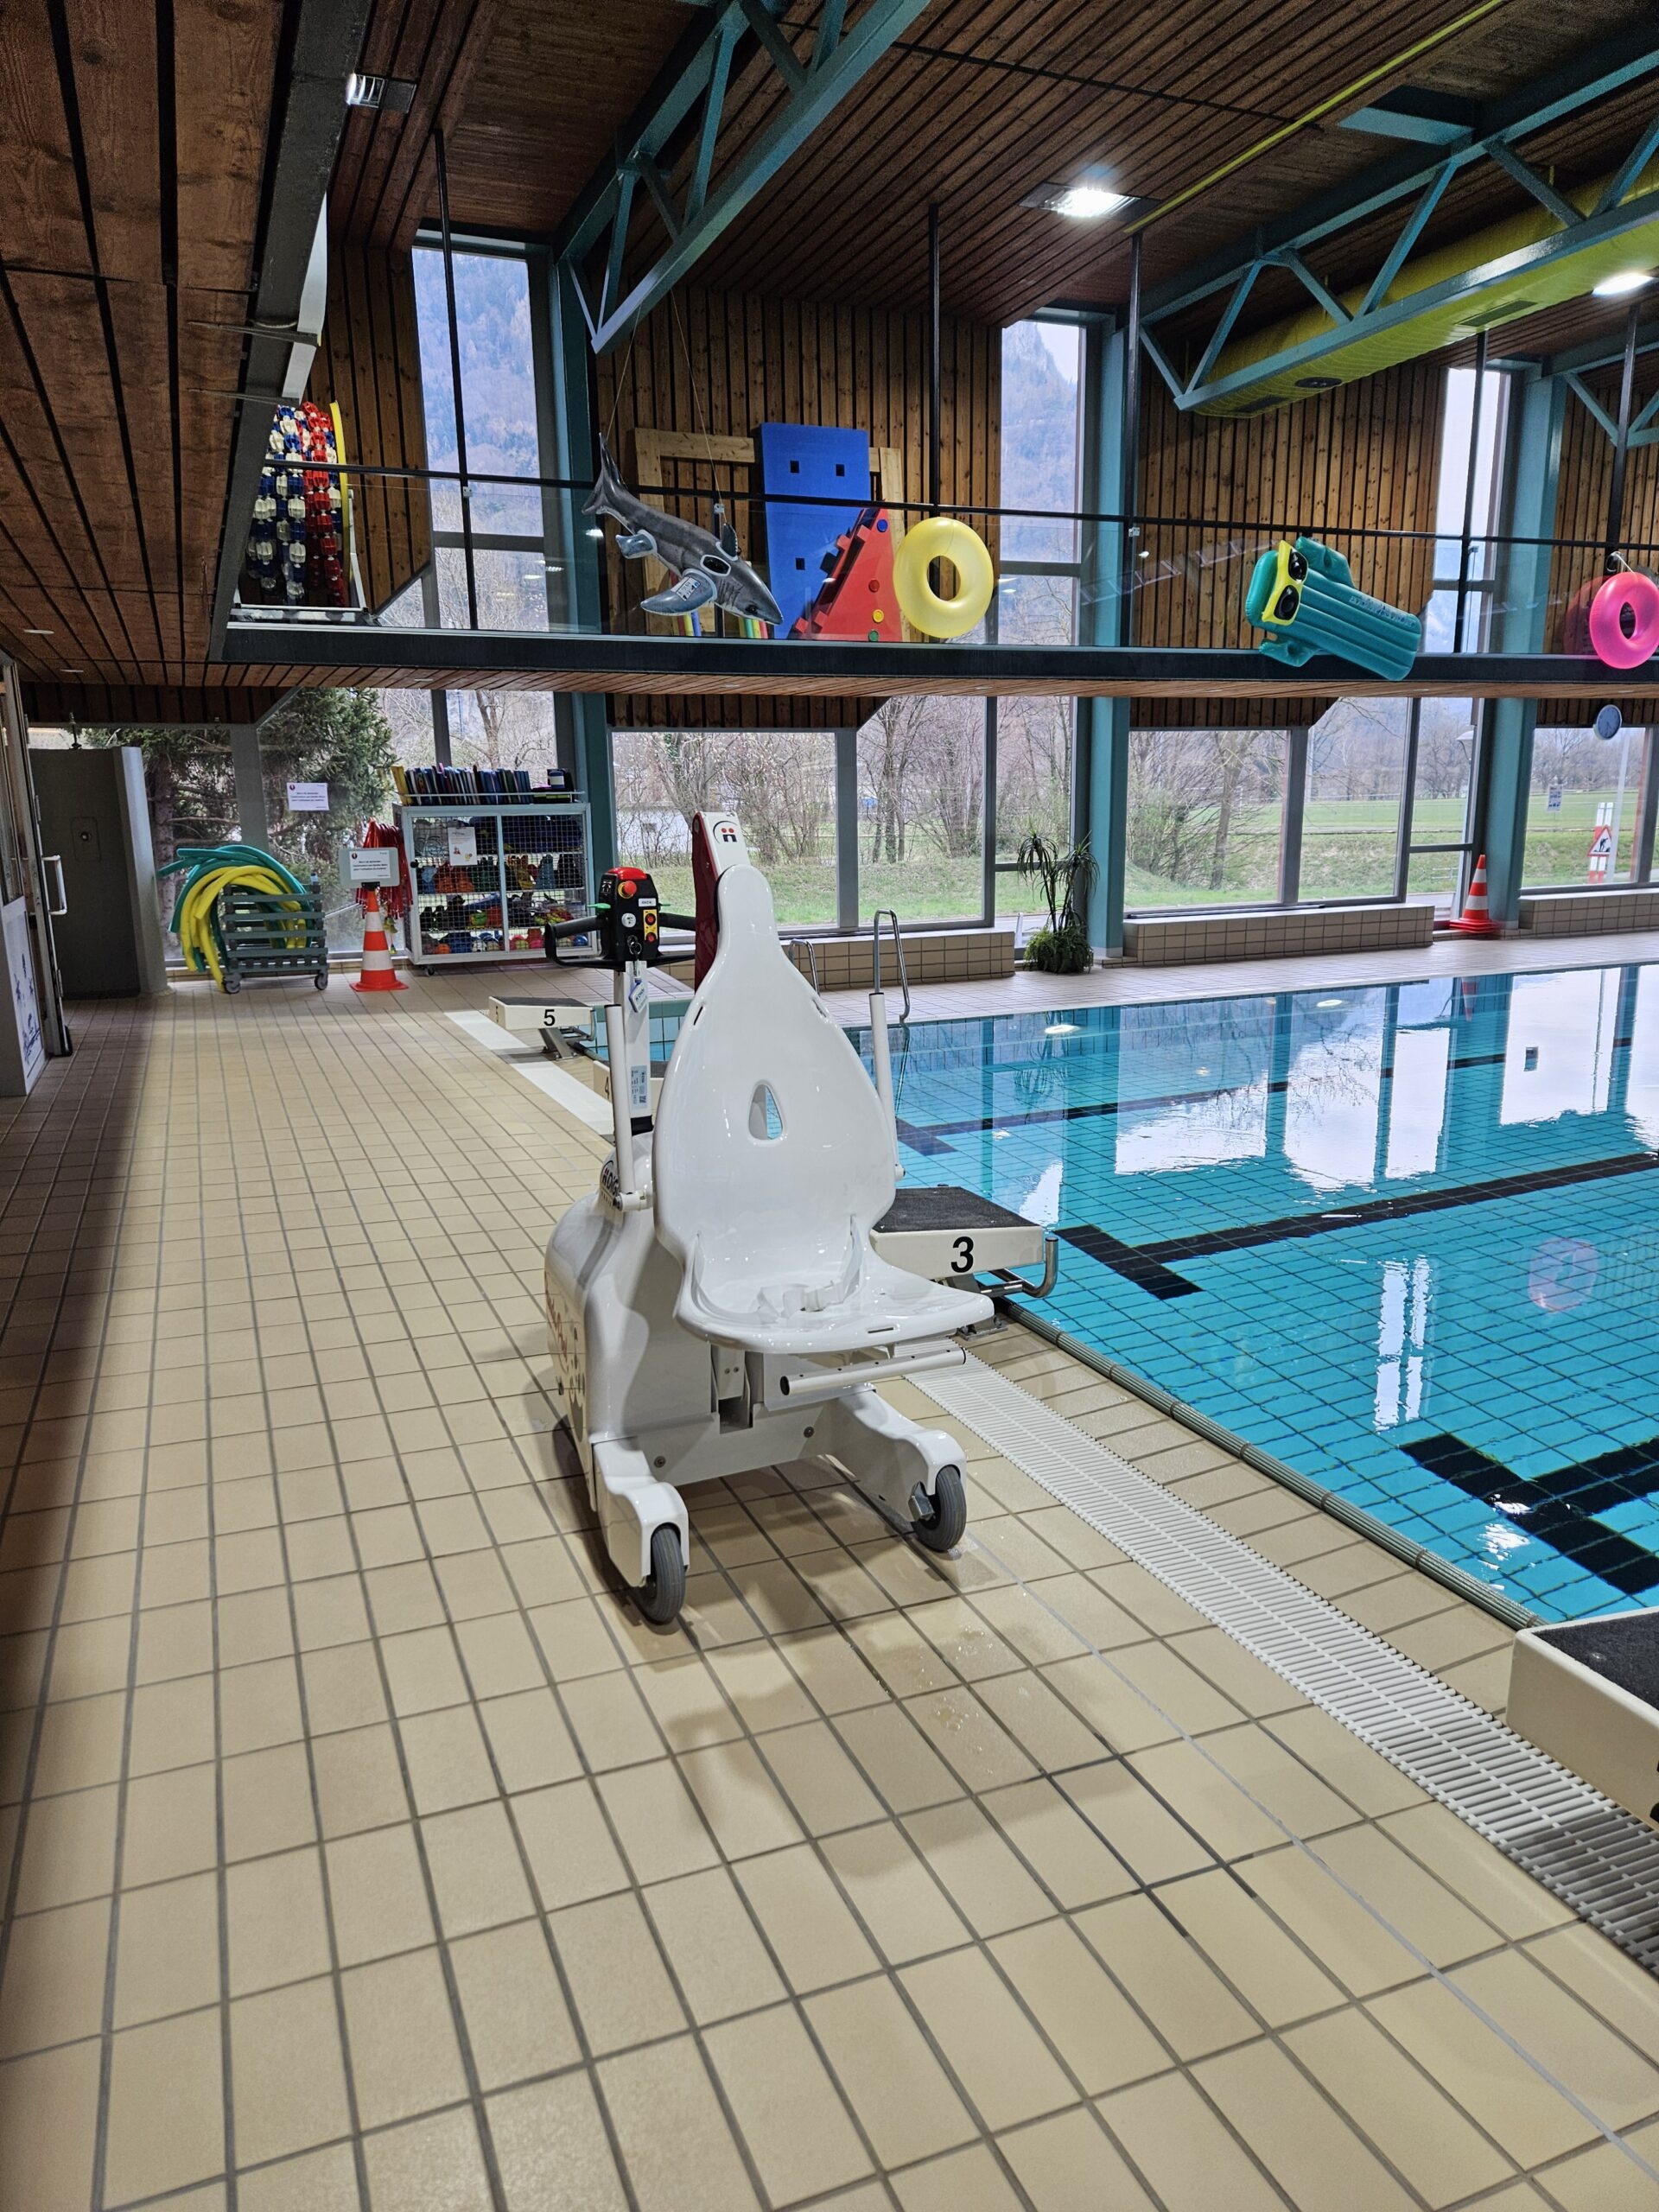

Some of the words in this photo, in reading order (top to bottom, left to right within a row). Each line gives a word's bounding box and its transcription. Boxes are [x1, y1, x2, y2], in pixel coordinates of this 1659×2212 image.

[543, 1009, 556, 1027] 5
[605, 1077, 610, 1100] 4
[950, 1236, 974, 1274] 3
